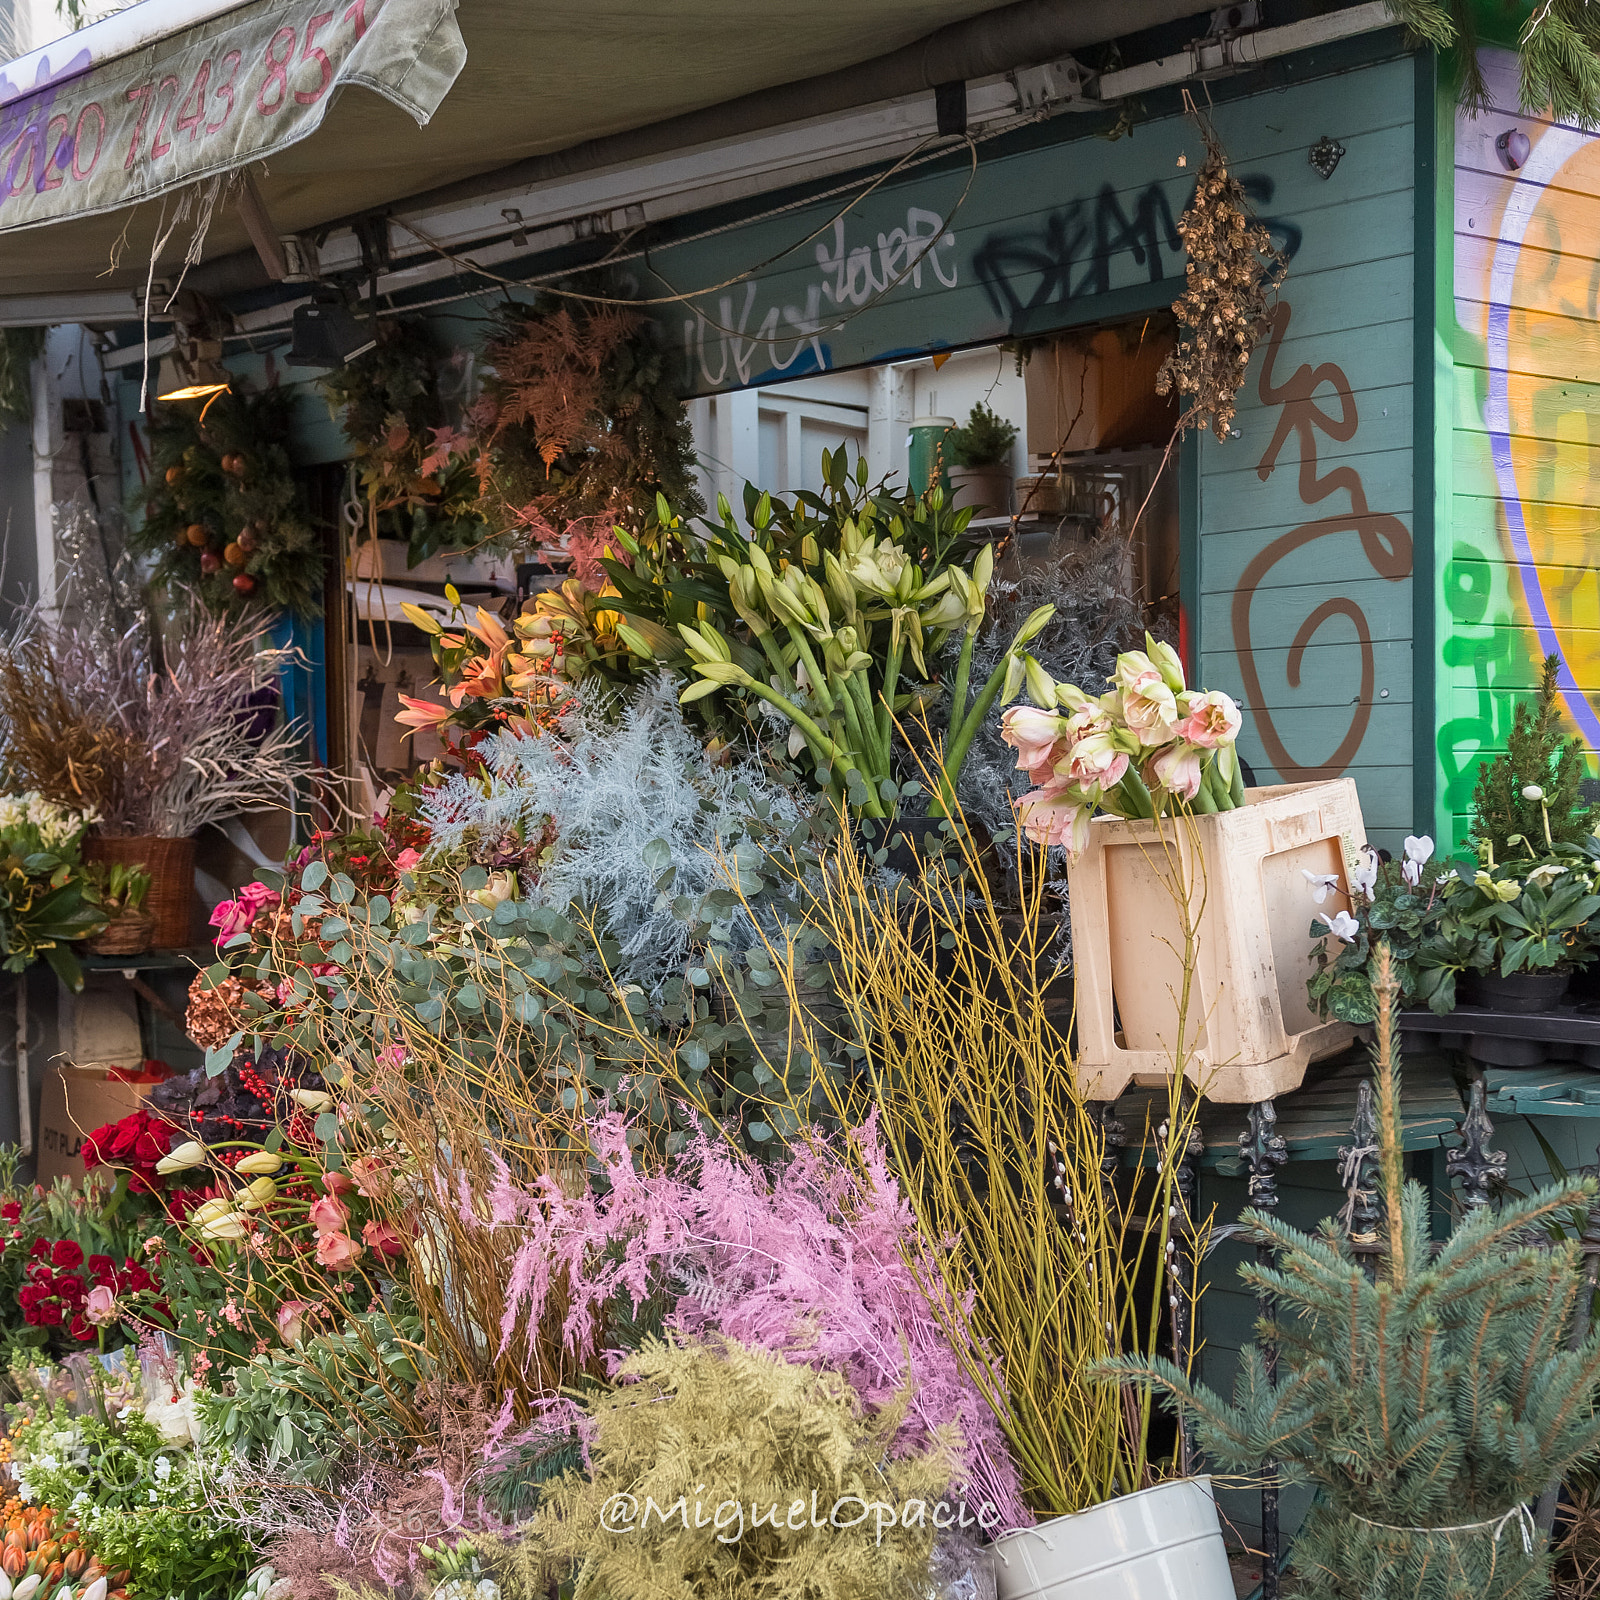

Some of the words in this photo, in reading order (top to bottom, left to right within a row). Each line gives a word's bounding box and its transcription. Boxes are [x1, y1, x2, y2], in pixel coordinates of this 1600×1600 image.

[4, 102, 106, 197] 020
[124, 49, 242, 169] 7243
[60, 1132, 88, 1158] PLA
